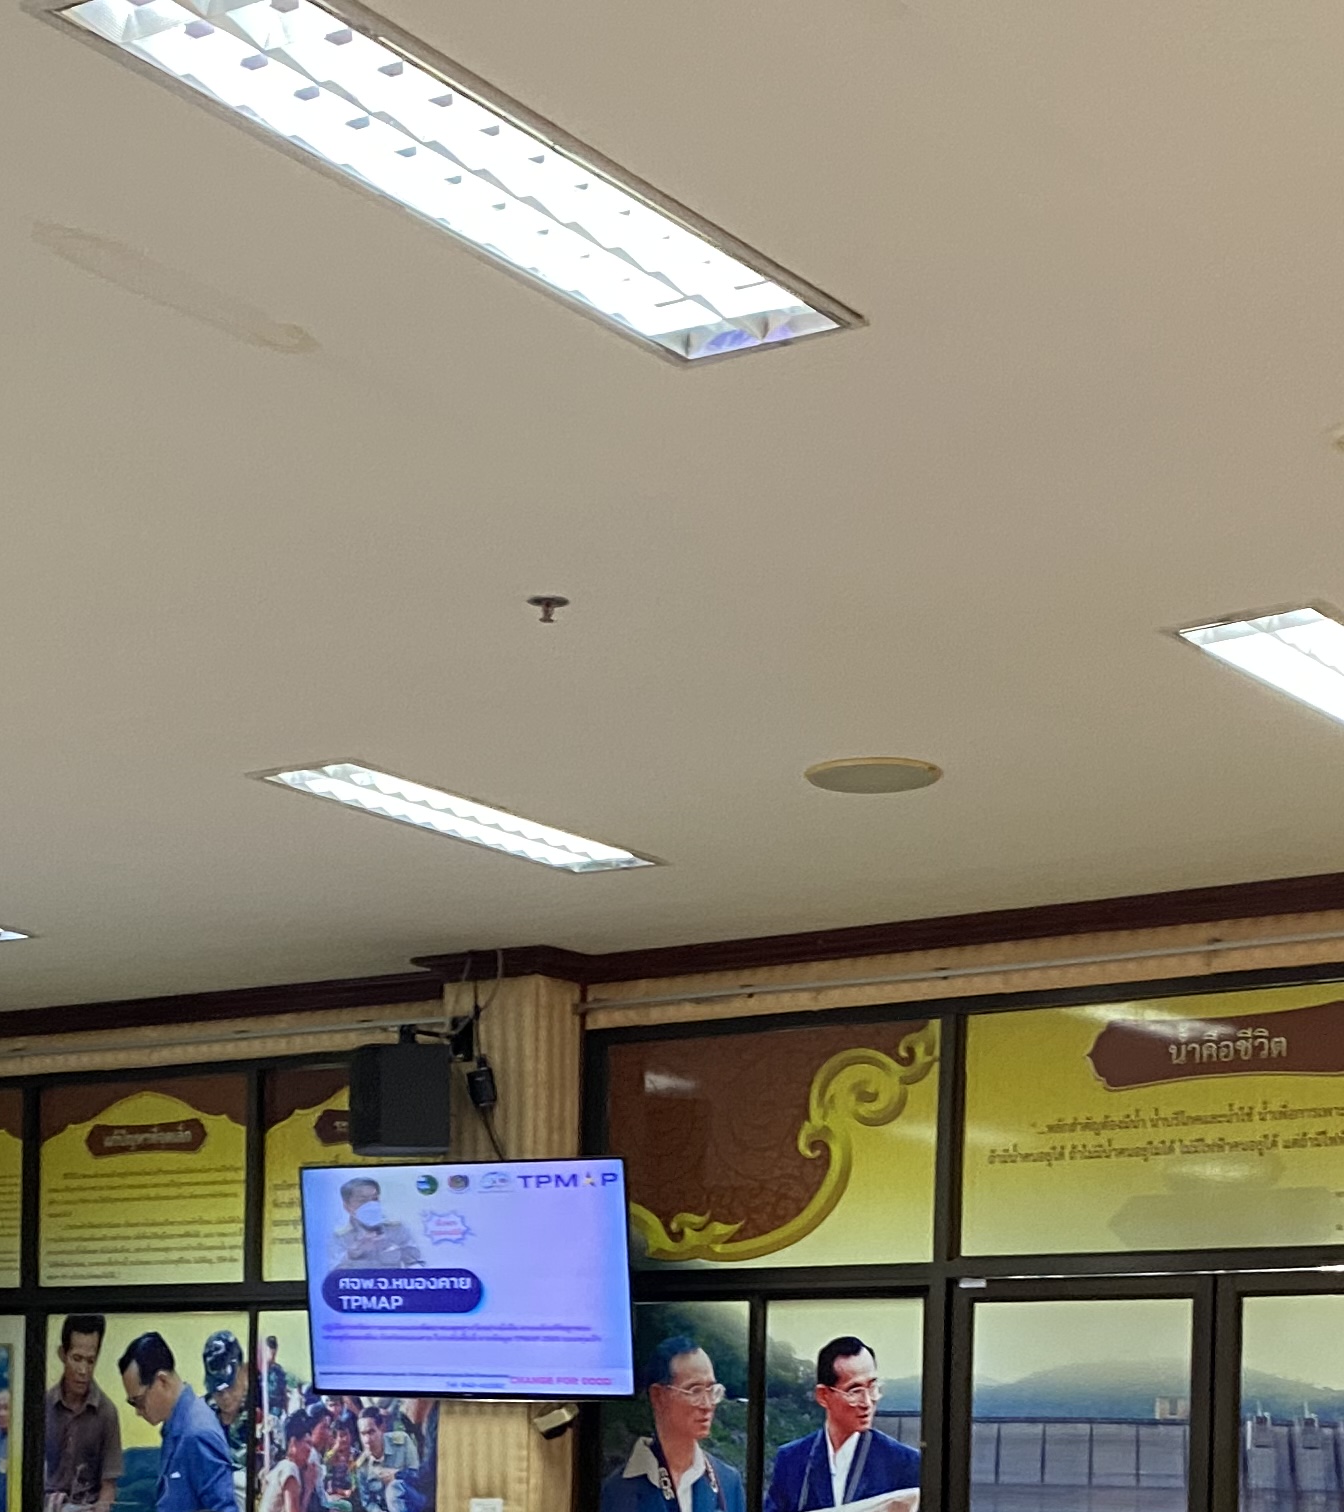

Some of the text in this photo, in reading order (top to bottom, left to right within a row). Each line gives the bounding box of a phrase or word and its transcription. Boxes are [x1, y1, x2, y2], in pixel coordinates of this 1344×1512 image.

[1168, 1024, 1288, 1065] น้ำคือชีวิต
[338, 1295, 404, 1310] TPMAP
